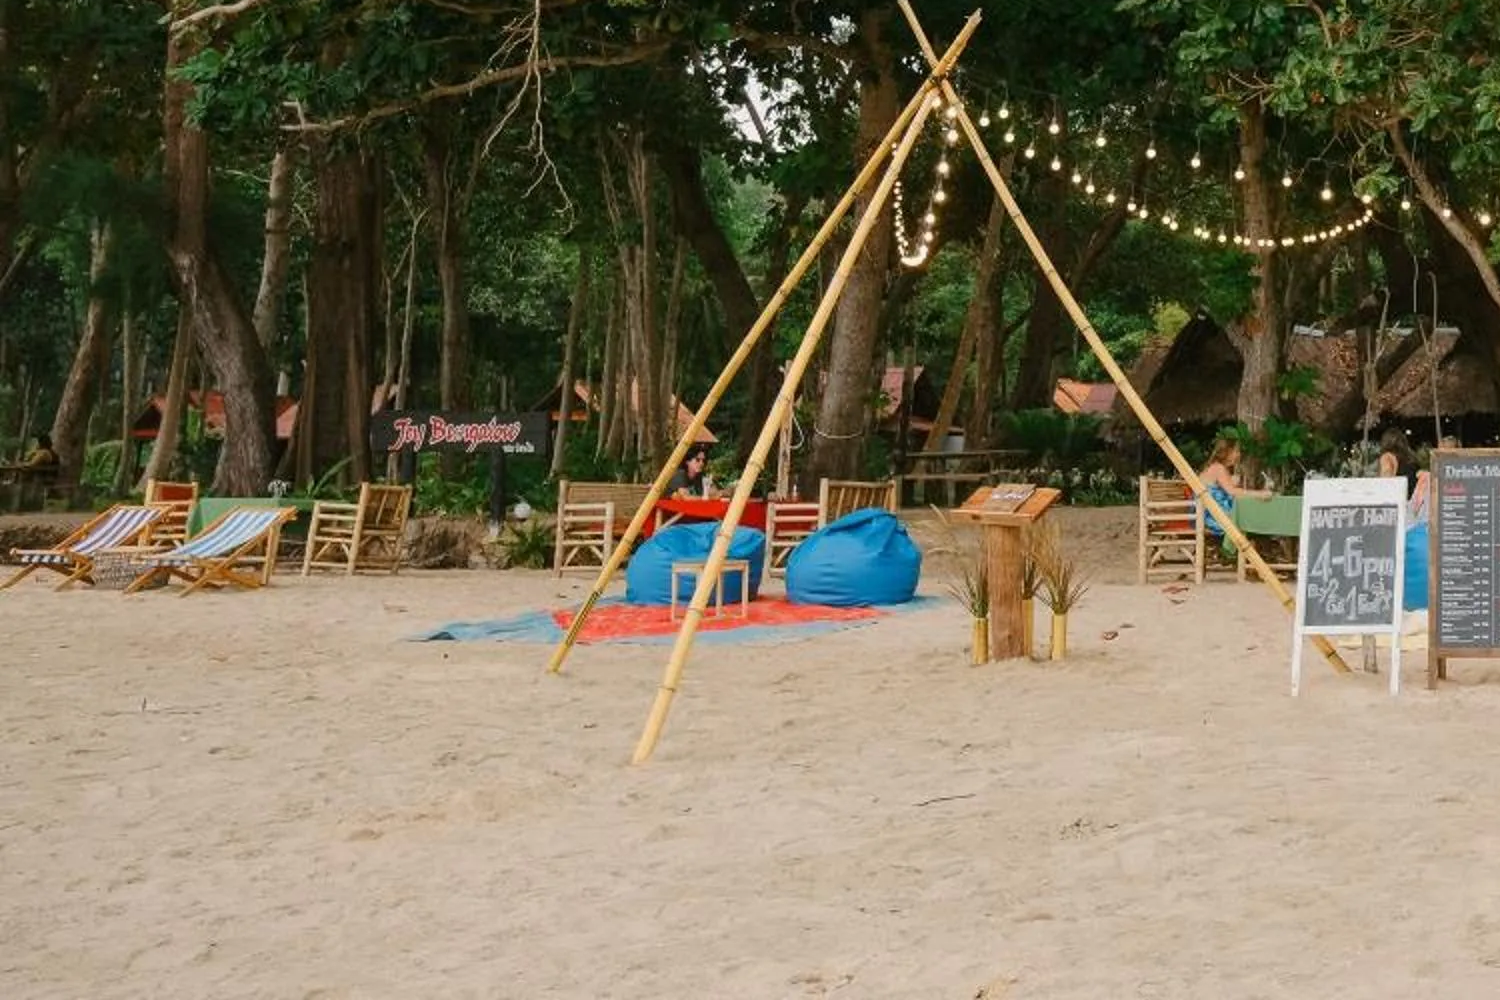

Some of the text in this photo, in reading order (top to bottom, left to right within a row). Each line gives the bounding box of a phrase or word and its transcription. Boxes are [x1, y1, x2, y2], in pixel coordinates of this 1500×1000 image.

[387, 417, 426, 452] Joy
[1444, 464, 1482, 479] Drink
[1311, 508, 1358, 529] HAPPY
